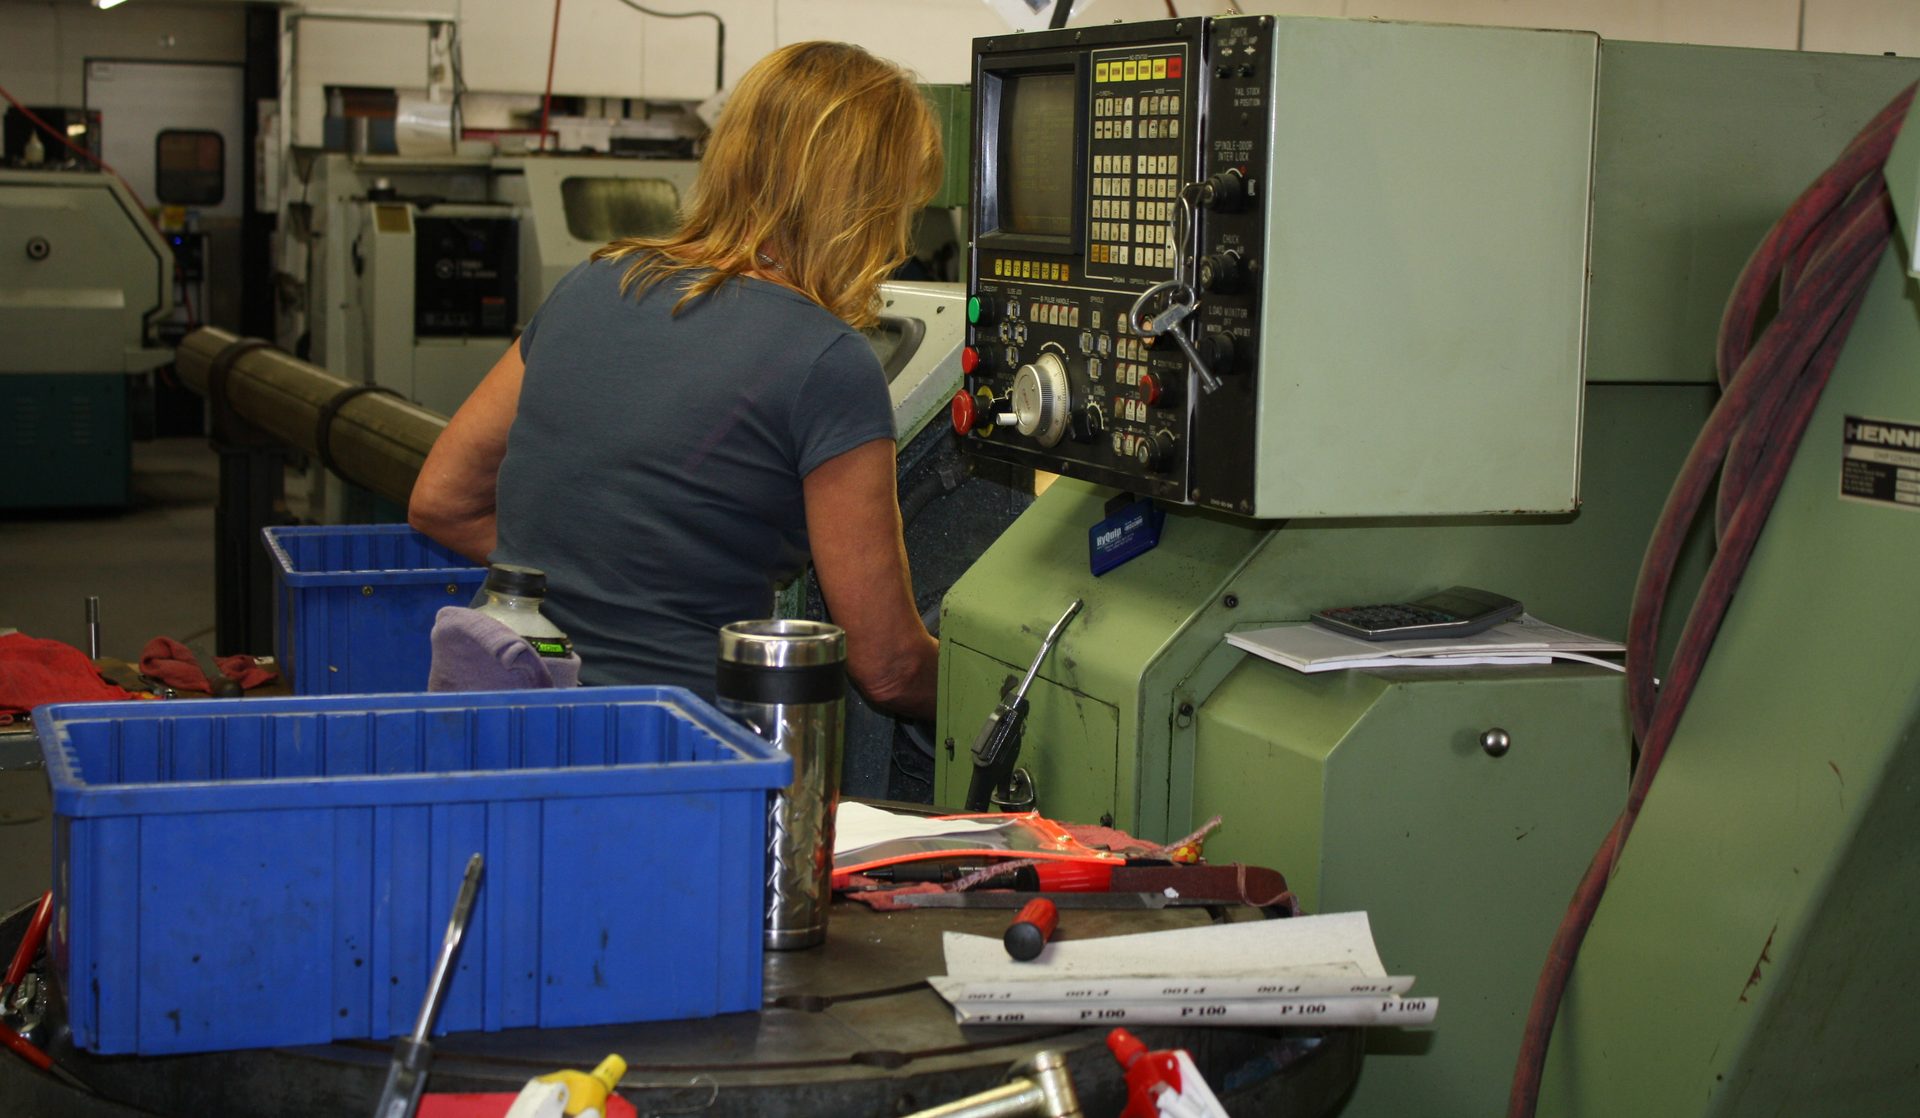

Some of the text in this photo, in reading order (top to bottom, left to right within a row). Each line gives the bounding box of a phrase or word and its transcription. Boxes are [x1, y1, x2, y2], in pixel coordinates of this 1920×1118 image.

[1181, 1005, 1227, 1017] P 100
[1280, 1004, 1327, 1015] P 100
[1381, 1000, 1427, 1012] P 100
[997, 1013, 1025, 1021] 100
[1080, 1009, 1125, 1019] P 100
